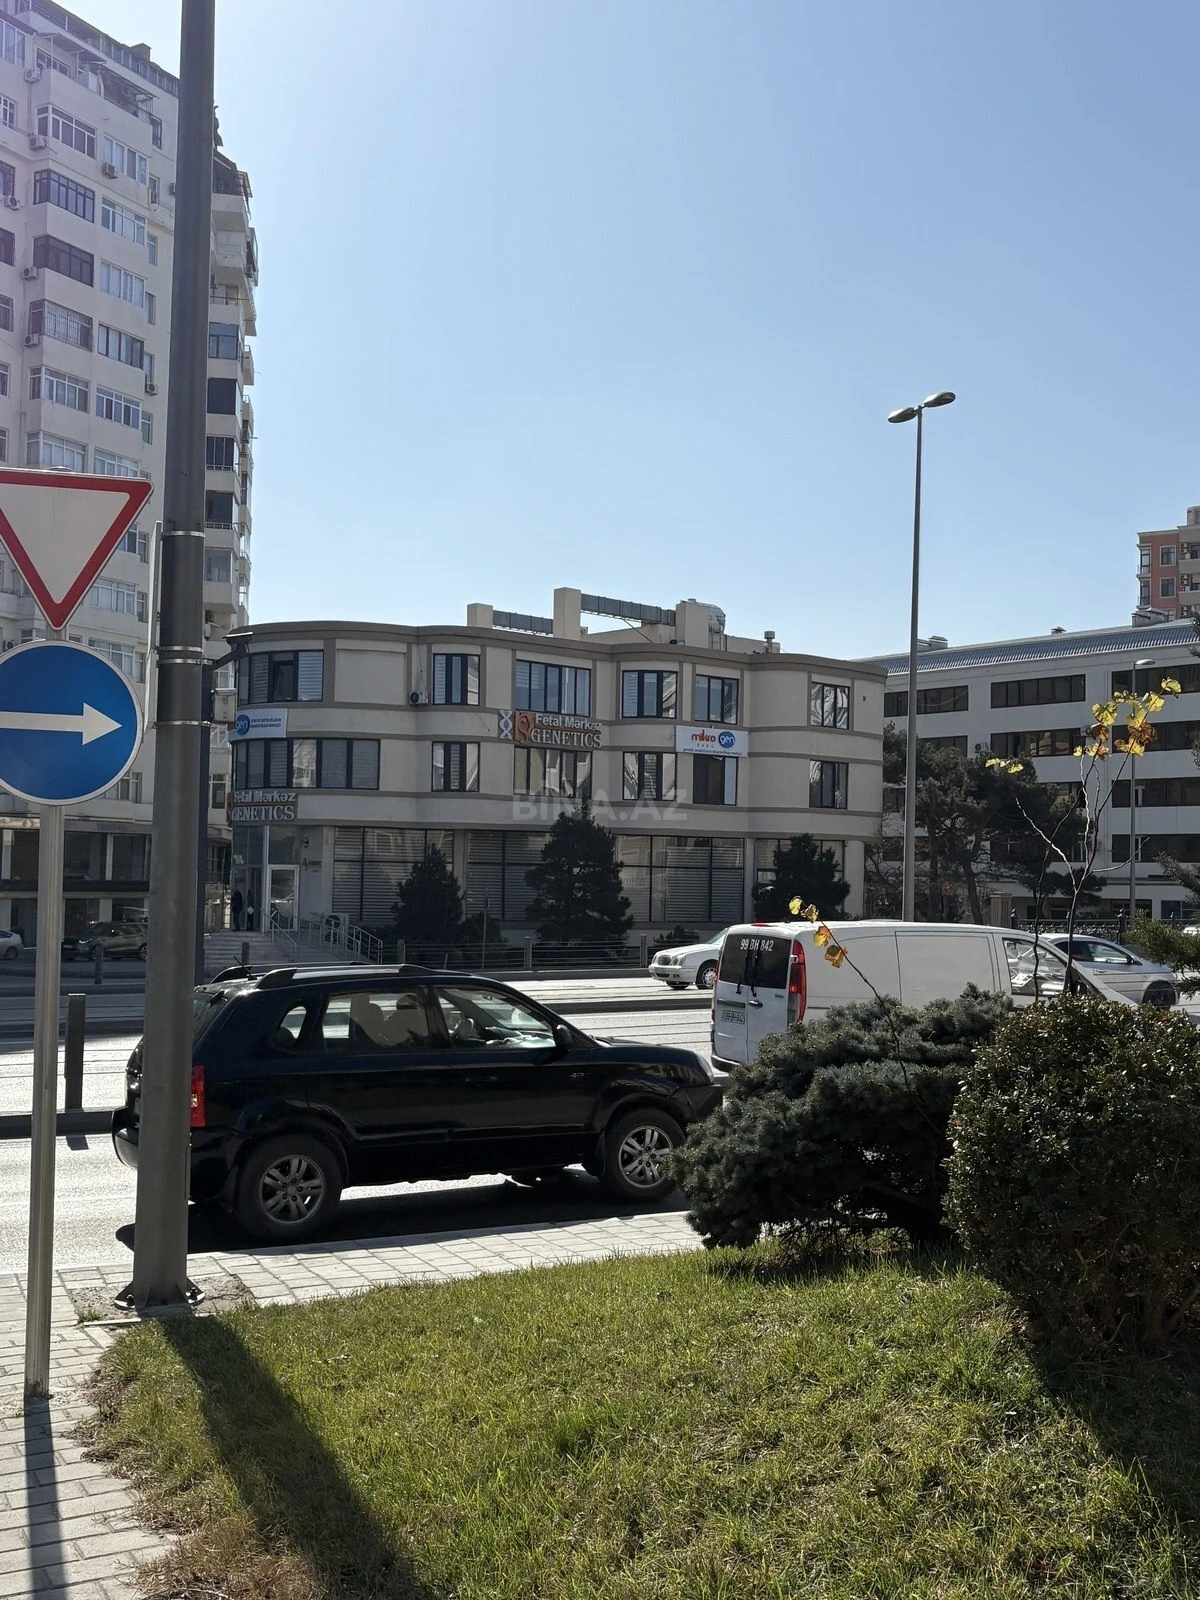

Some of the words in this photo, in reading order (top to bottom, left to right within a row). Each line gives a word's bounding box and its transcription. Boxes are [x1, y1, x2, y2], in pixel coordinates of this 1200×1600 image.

[534, 713, 561, 727] Fetal
[530, 728, 602, 749] GENETICS
[691, 729, 716, 743] mikro
[719, 735, 735, 745] gen
[234, 791, 252, 803] Fetal
[253, 790, 297, 803] Mərkəz
[231, 805, 295, 821] GENETICS
[740, 938, 749, 950] 99
[760, 940, 774, 952] 842
